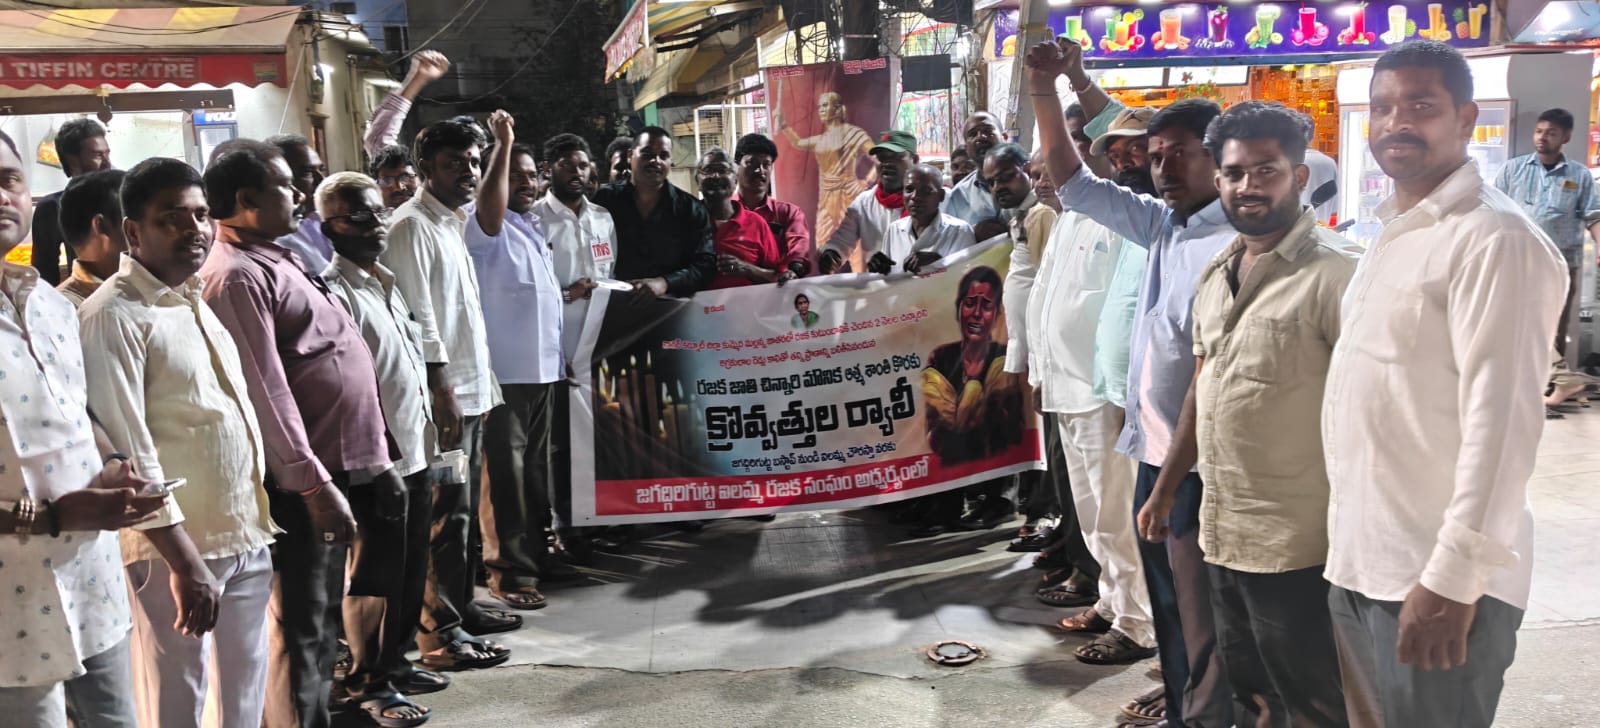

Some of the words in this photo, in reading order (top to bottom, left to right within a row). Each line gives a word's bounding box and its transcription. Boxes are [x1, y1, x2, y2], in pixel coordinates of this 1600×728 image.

[10, 62, 94, 78] TIFFIN
[100, 62, 195, 78] CENTRE
[795, 331, 810, 341] రజక
[850, 320, 874, 332] చెందిన
[875, 318, 881, 327] 2
[881, 315, 898, 326] నెలల
[697, 379, 727, 395] రజక
[730, 378, 758, 395] జాతి
[760, 373, 801, 396] చిన్నారి
[803, 367, 843, 388] మౌనిక
[865, 358, 891, 378] శాంతి
[892, 352, 920, 373] కొరకు
[705, 399, 839, 451] క్రొవ్వత్తుల
[844, 376, 916, 437] ర్యాలీ
[731, 458, 772, 473] జగద్గిరిగుట్ట
[773, 453, 796, 470] బస్టాప్
[875, 441, 896, 454] వరకు
[636, 482, 716, 511] జగద్గిరిగుట్ట
[718, 480, 764, 504] ఐలమ్మ
[765, 477, 801, 498] రజక
[803, 473, 852, 496] సంఘం
